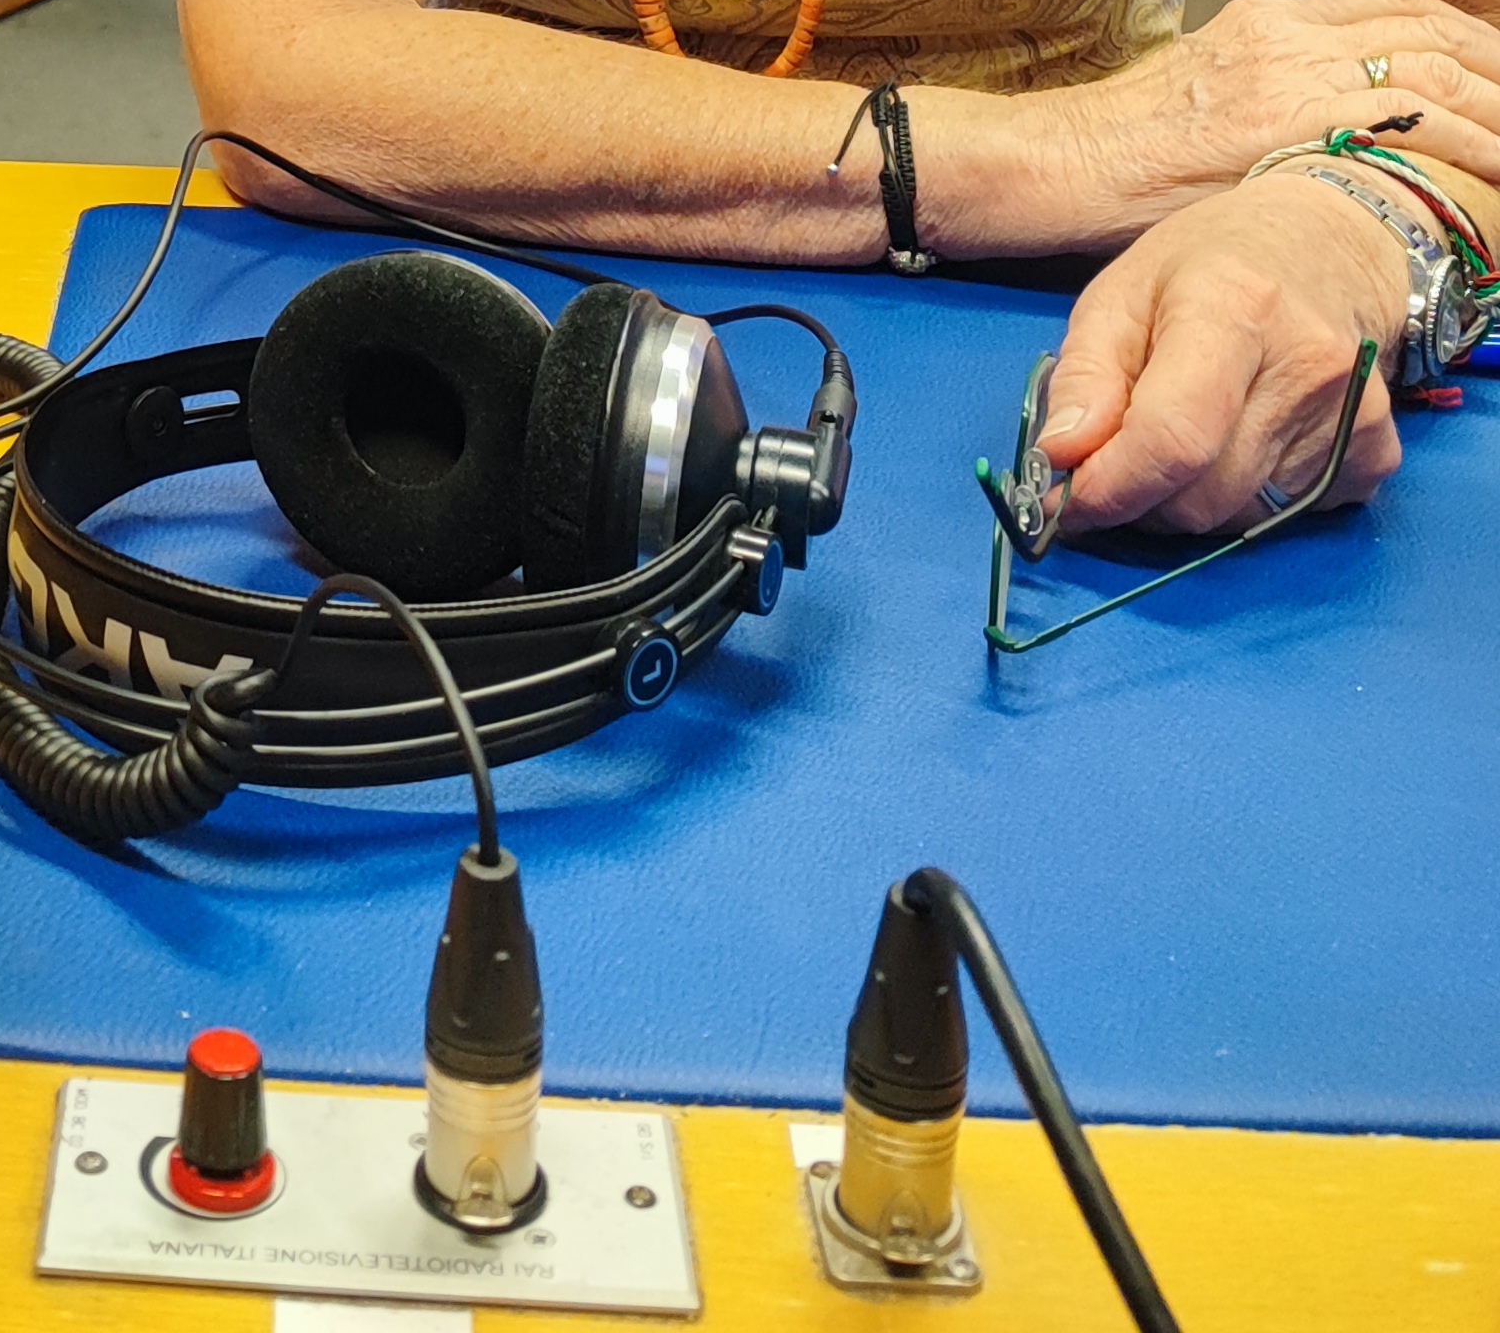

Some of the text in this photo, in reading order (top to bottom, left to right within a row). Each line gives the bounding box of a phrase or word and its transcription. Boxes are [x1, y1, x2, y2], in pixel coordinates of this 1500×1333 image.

[147, 1240, 555, 1281] RAI RADIOTELEVISIONE ITALIANA
